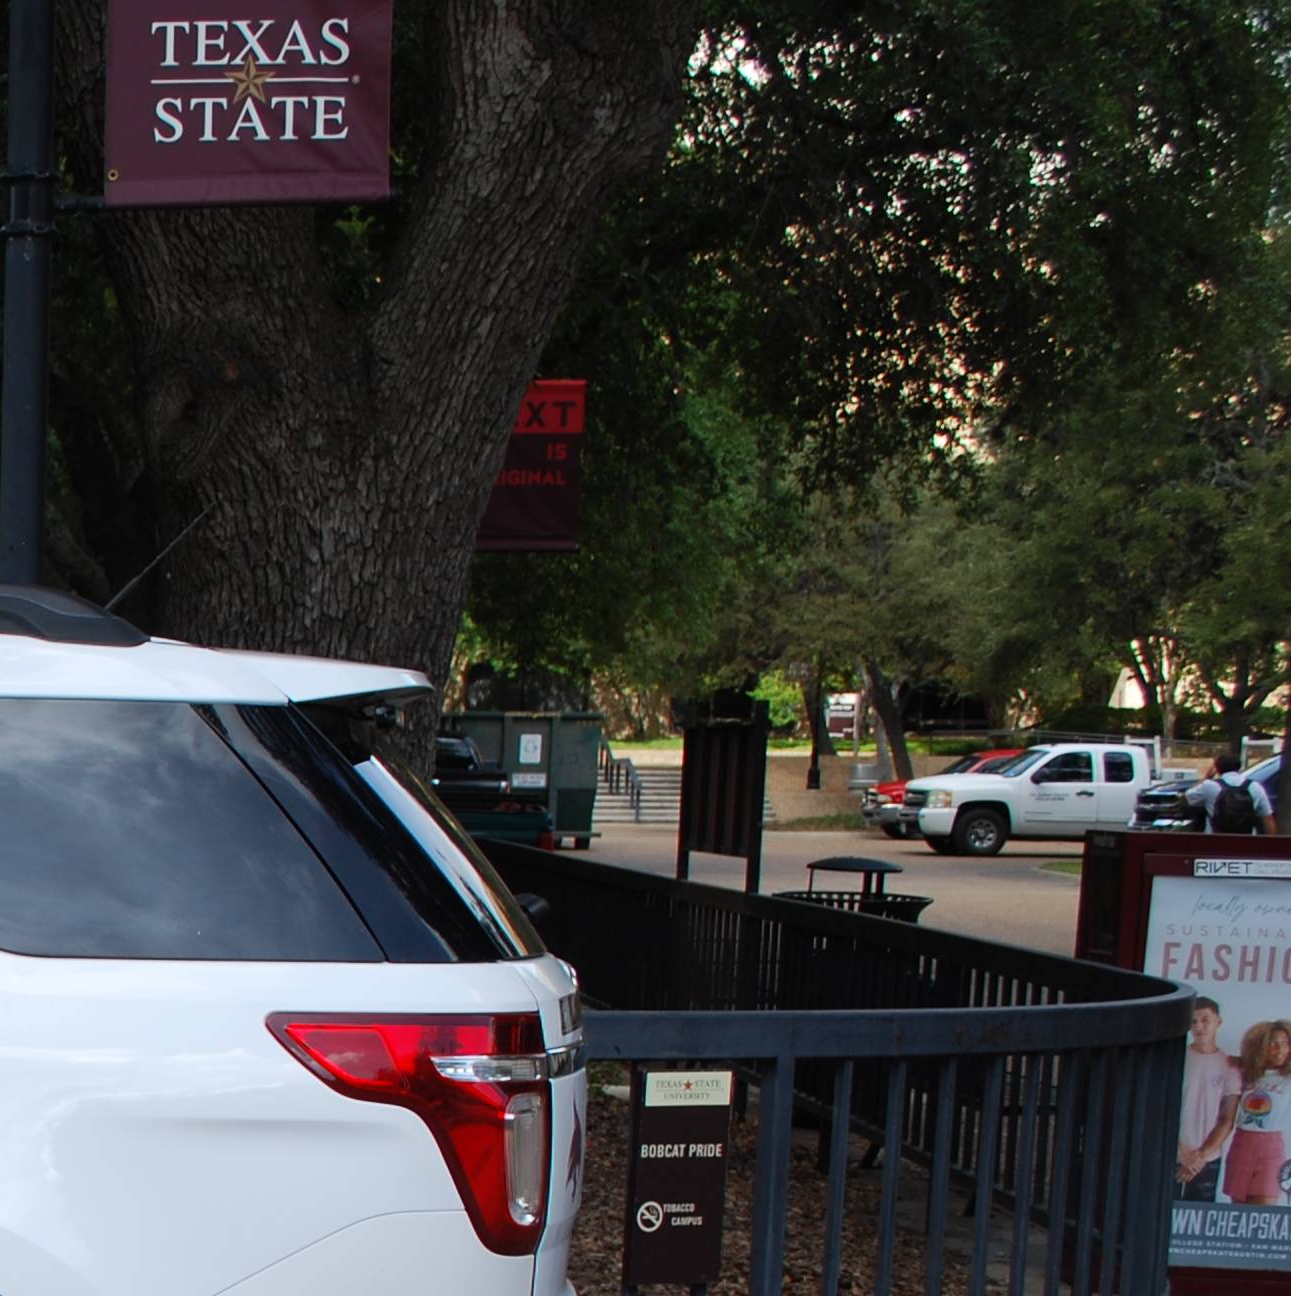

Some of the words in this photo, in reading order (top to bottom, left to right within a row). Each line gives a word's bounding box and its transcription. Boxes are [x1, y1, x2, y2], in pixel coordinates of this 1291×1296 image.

[151, 18, 350, 67] TEXAS
[153, 95, 349, 143] STATE
[547, 443, 568, 461] IS
[1195, 861, 1254, 874] RIVET
[655, 1080, 682, 1088] TEXAS
[695, 1079, 721, 1088] STATE
[663, 1092, 710, 1100] UNIVERSITY
[640, 1144, 686, 1158] BOBCAT
[688, 1143, 723, 1157] PRIDE
[663, 1203, 695, 1213] TOBACCO
[671, 1216, 702, 1226] CAMPUS
